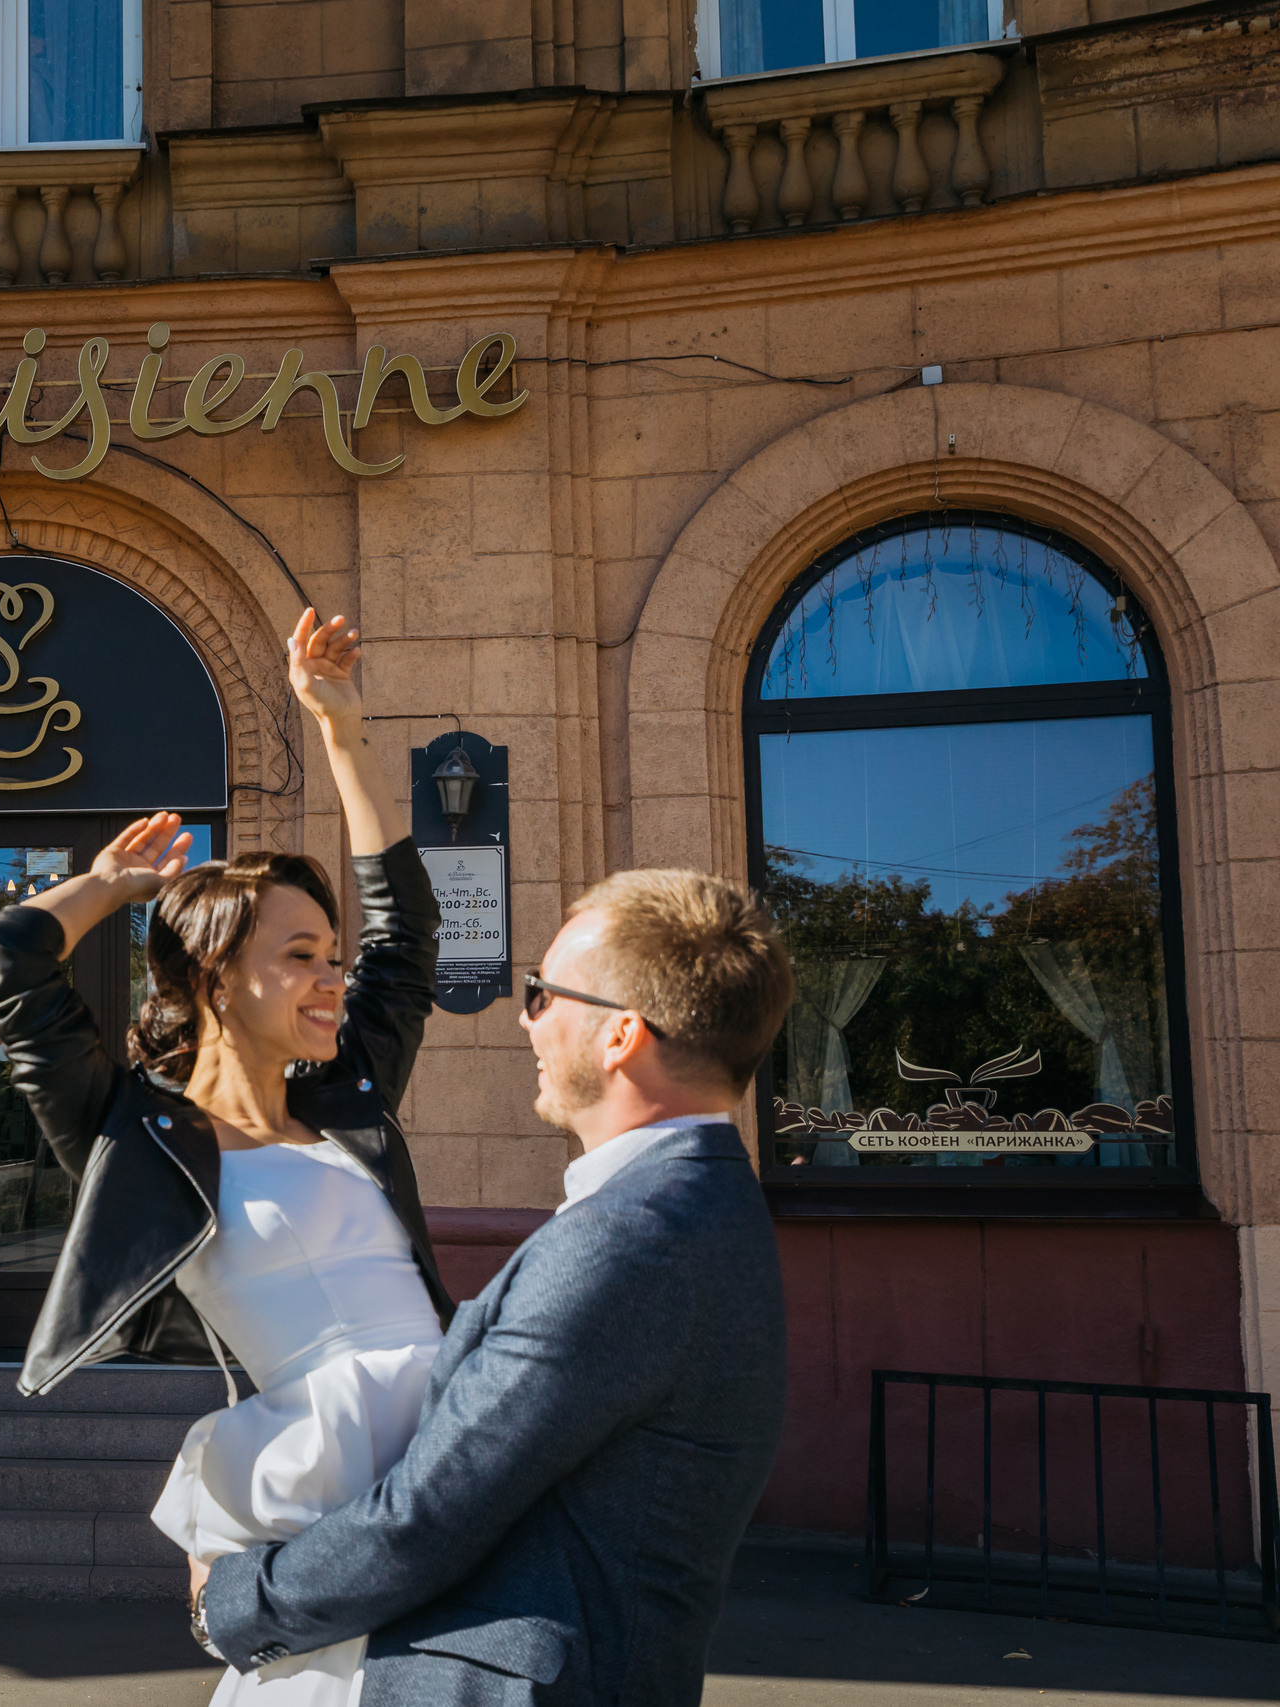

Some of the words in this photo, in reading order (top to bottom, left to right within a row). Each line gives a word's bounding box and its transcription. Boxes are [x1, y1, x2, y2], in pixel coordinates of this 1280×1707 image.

[437, 899, 498, 909] :00-22:00
[442, 917, 482, 928] Пт.-Сб.
[433, 930, 500, 940] 9:00-22:00
[858, 1135, 894, 1147] СЕТЬ
[898, 1135, 960, 1147] КОФЕЕН
[966, 1135, 1084, 1148] «ПАРИЖАНКА»
